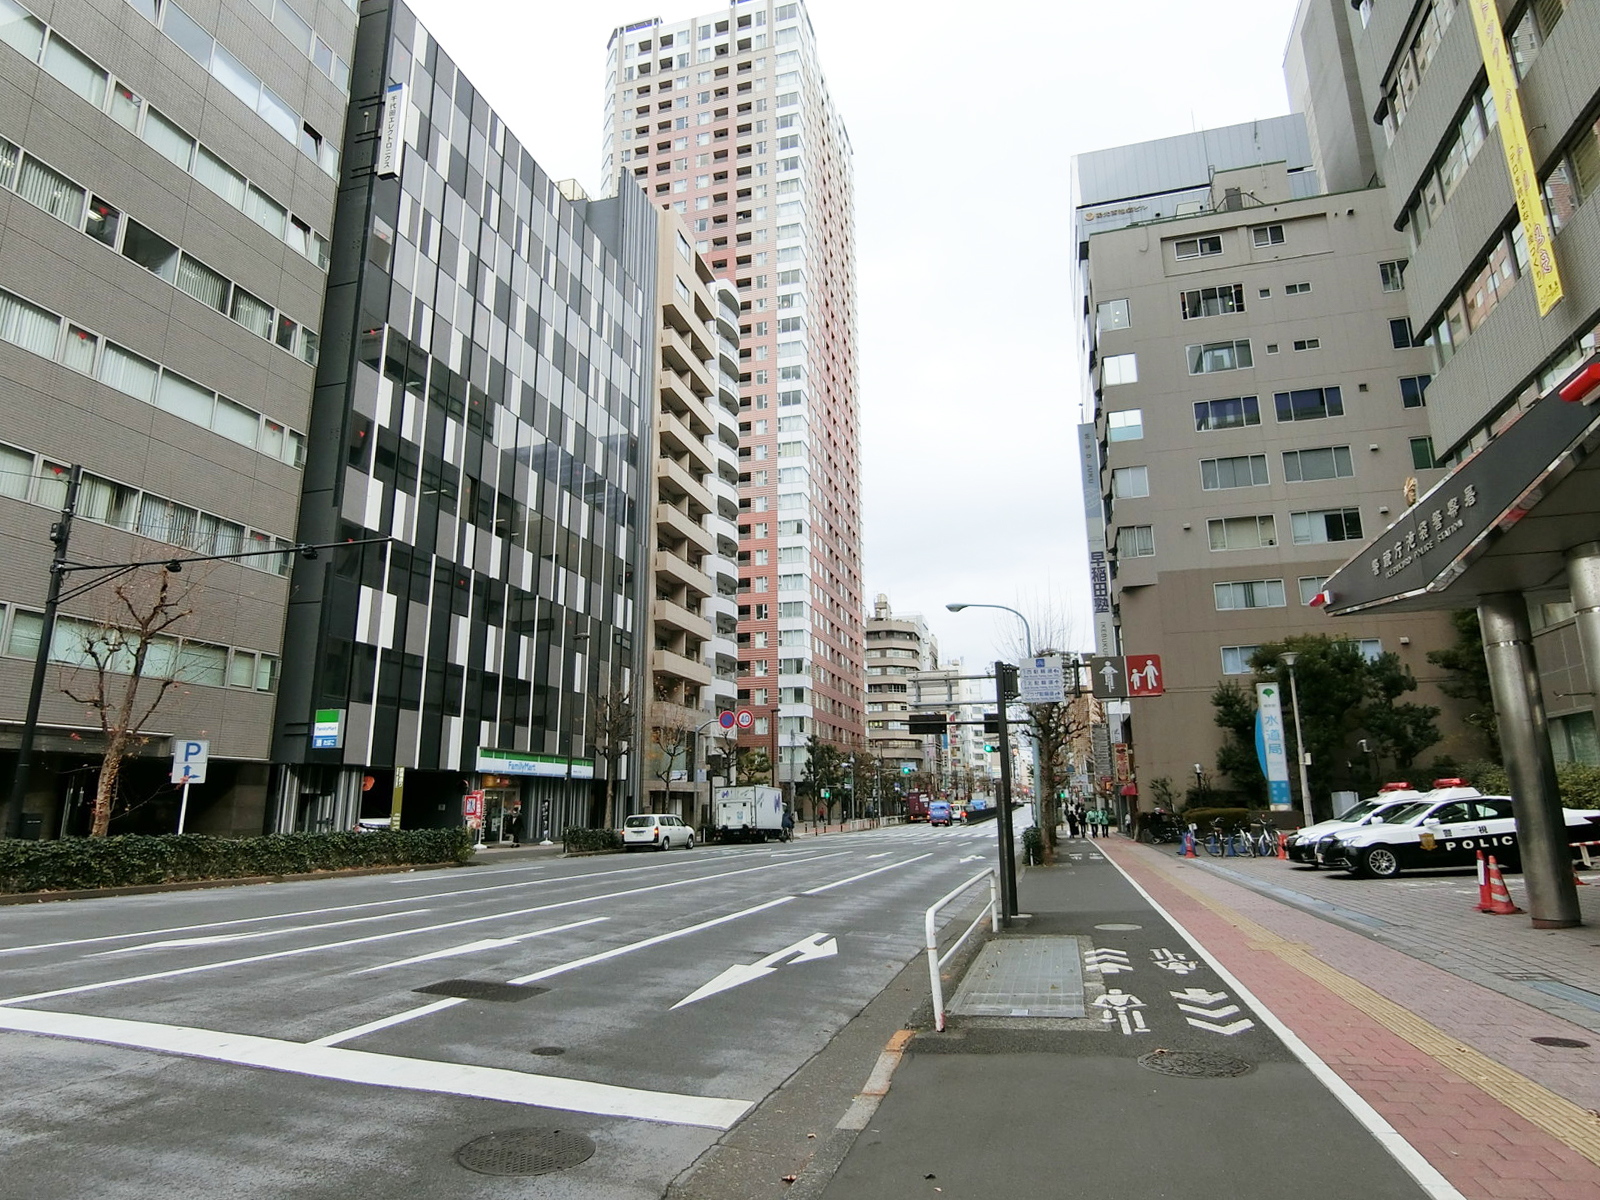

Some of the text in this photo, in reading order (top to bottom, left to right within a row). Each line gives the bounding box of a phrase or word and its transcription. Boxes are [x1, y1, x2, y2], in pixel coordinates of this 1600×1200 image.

[384, 95, 397, 169] 千代田エレクトロニクス
[1371, 484, 1476, 577] 警視庁池袋警察署
[1413, 540, 1435, 560] POLICE
[1436, 518, 1464, 543] STATION
[1090, 551, 1110, 613] 早稲田塾
[1100, 621, 1109, 656] IKEBUKU
[741, 715, 750, 724] 40
[1264, 715, 1283, 755] 水道局
[186, 742, 201, 762] P
[508, 761, 536, 772] FamilyMart
[1442, 825, 1488, 837] 警視
[1445, 835, 1514, 851] POLIC
